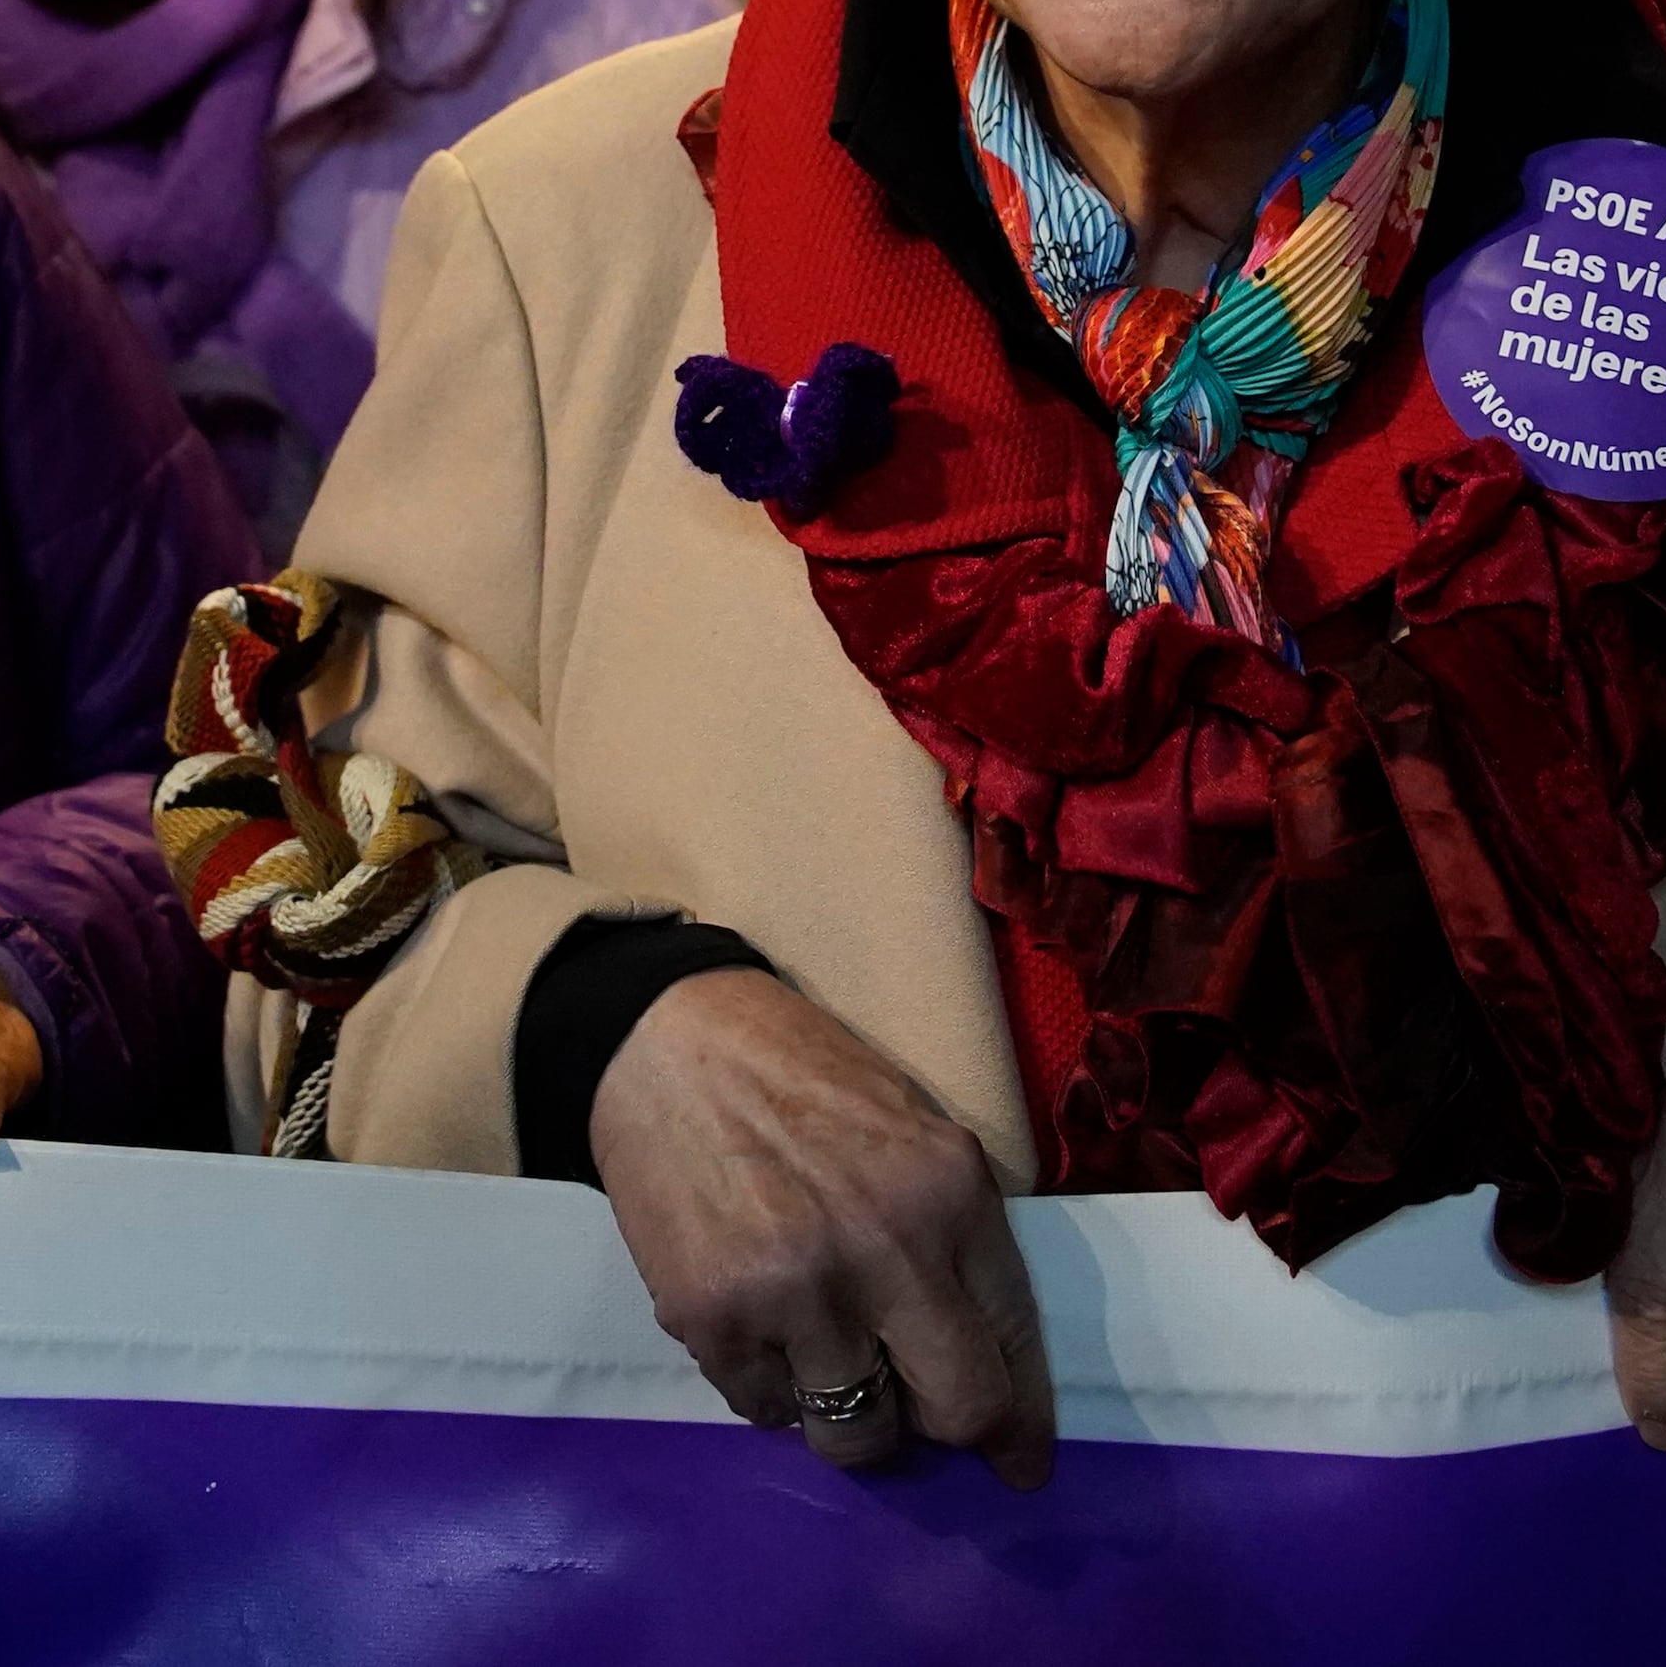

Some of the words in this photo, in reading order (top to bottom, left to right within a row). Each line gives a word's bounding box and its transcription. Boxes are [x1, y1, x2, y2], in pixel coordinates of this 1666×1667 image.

[1545, 178, 1653, 235] PSOE
[1522, 234, 1606, 283] Las
[1511, 280, 1572, 321] de
[1580, 291, 1651, 342] las
